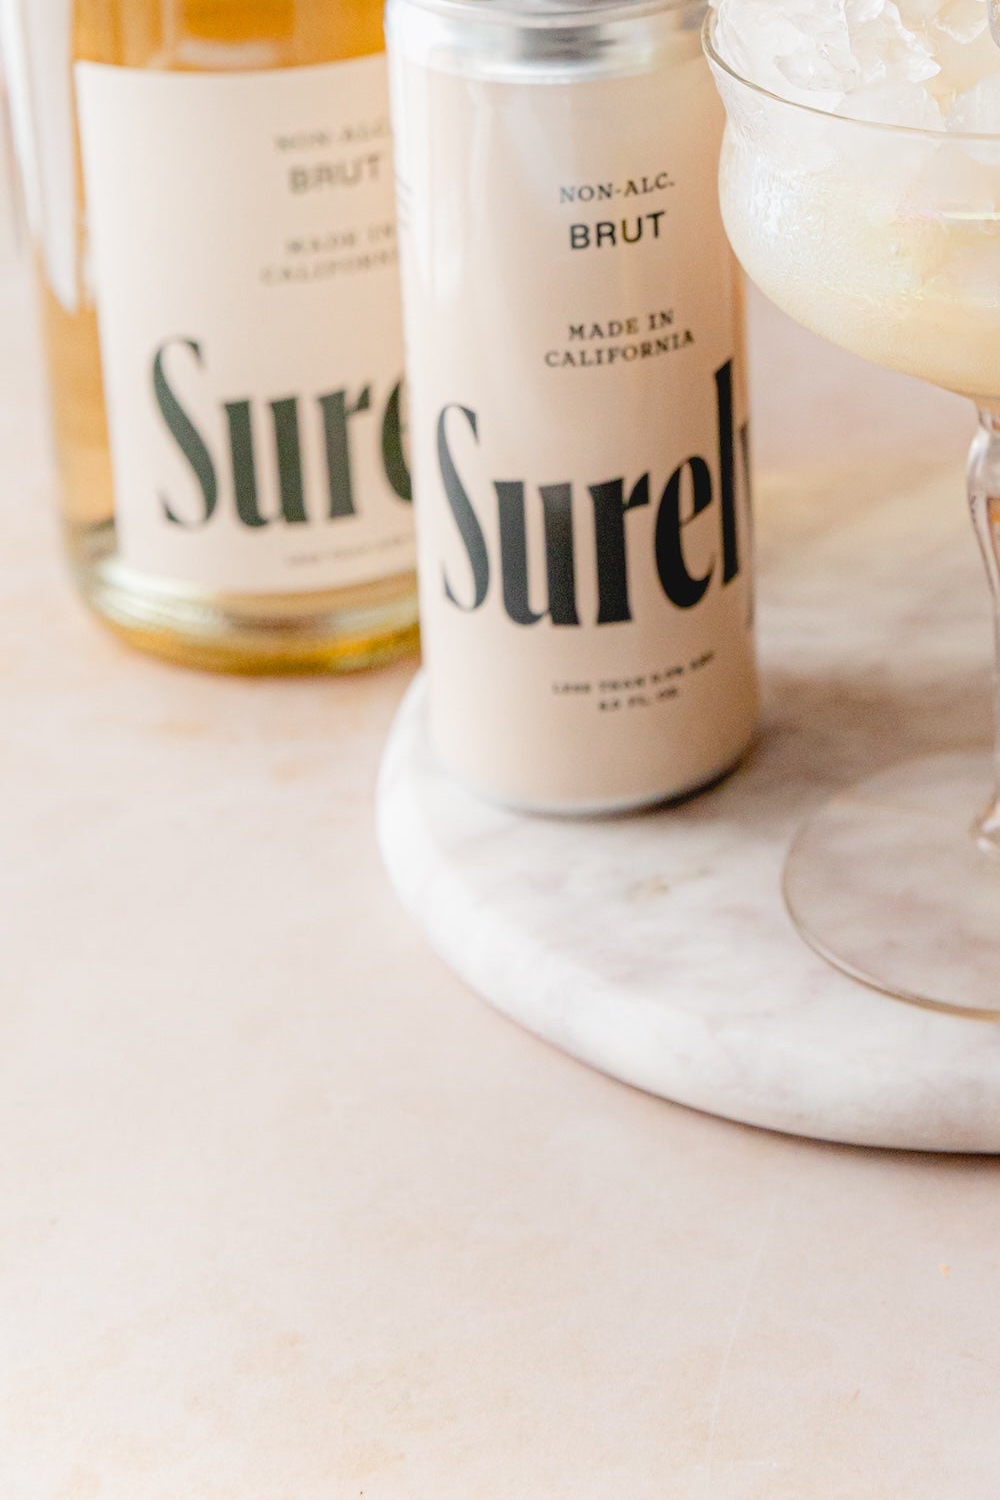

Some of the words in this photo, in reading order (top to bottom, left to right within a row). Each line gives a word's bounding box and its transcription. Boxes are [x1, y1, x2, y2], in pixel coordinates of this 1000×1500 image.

[289, 153, 383, 195] BRUT
[559, 172, 676, 203] NON-ALC.
[569, 210, 666, 250] BRUT
[568, 317, 639, 341] MADE
[648, 308, 674, 330] IN
[544, 329, 695, 368] CALIFORNIA
[437, 357, 754, 628] Surel
